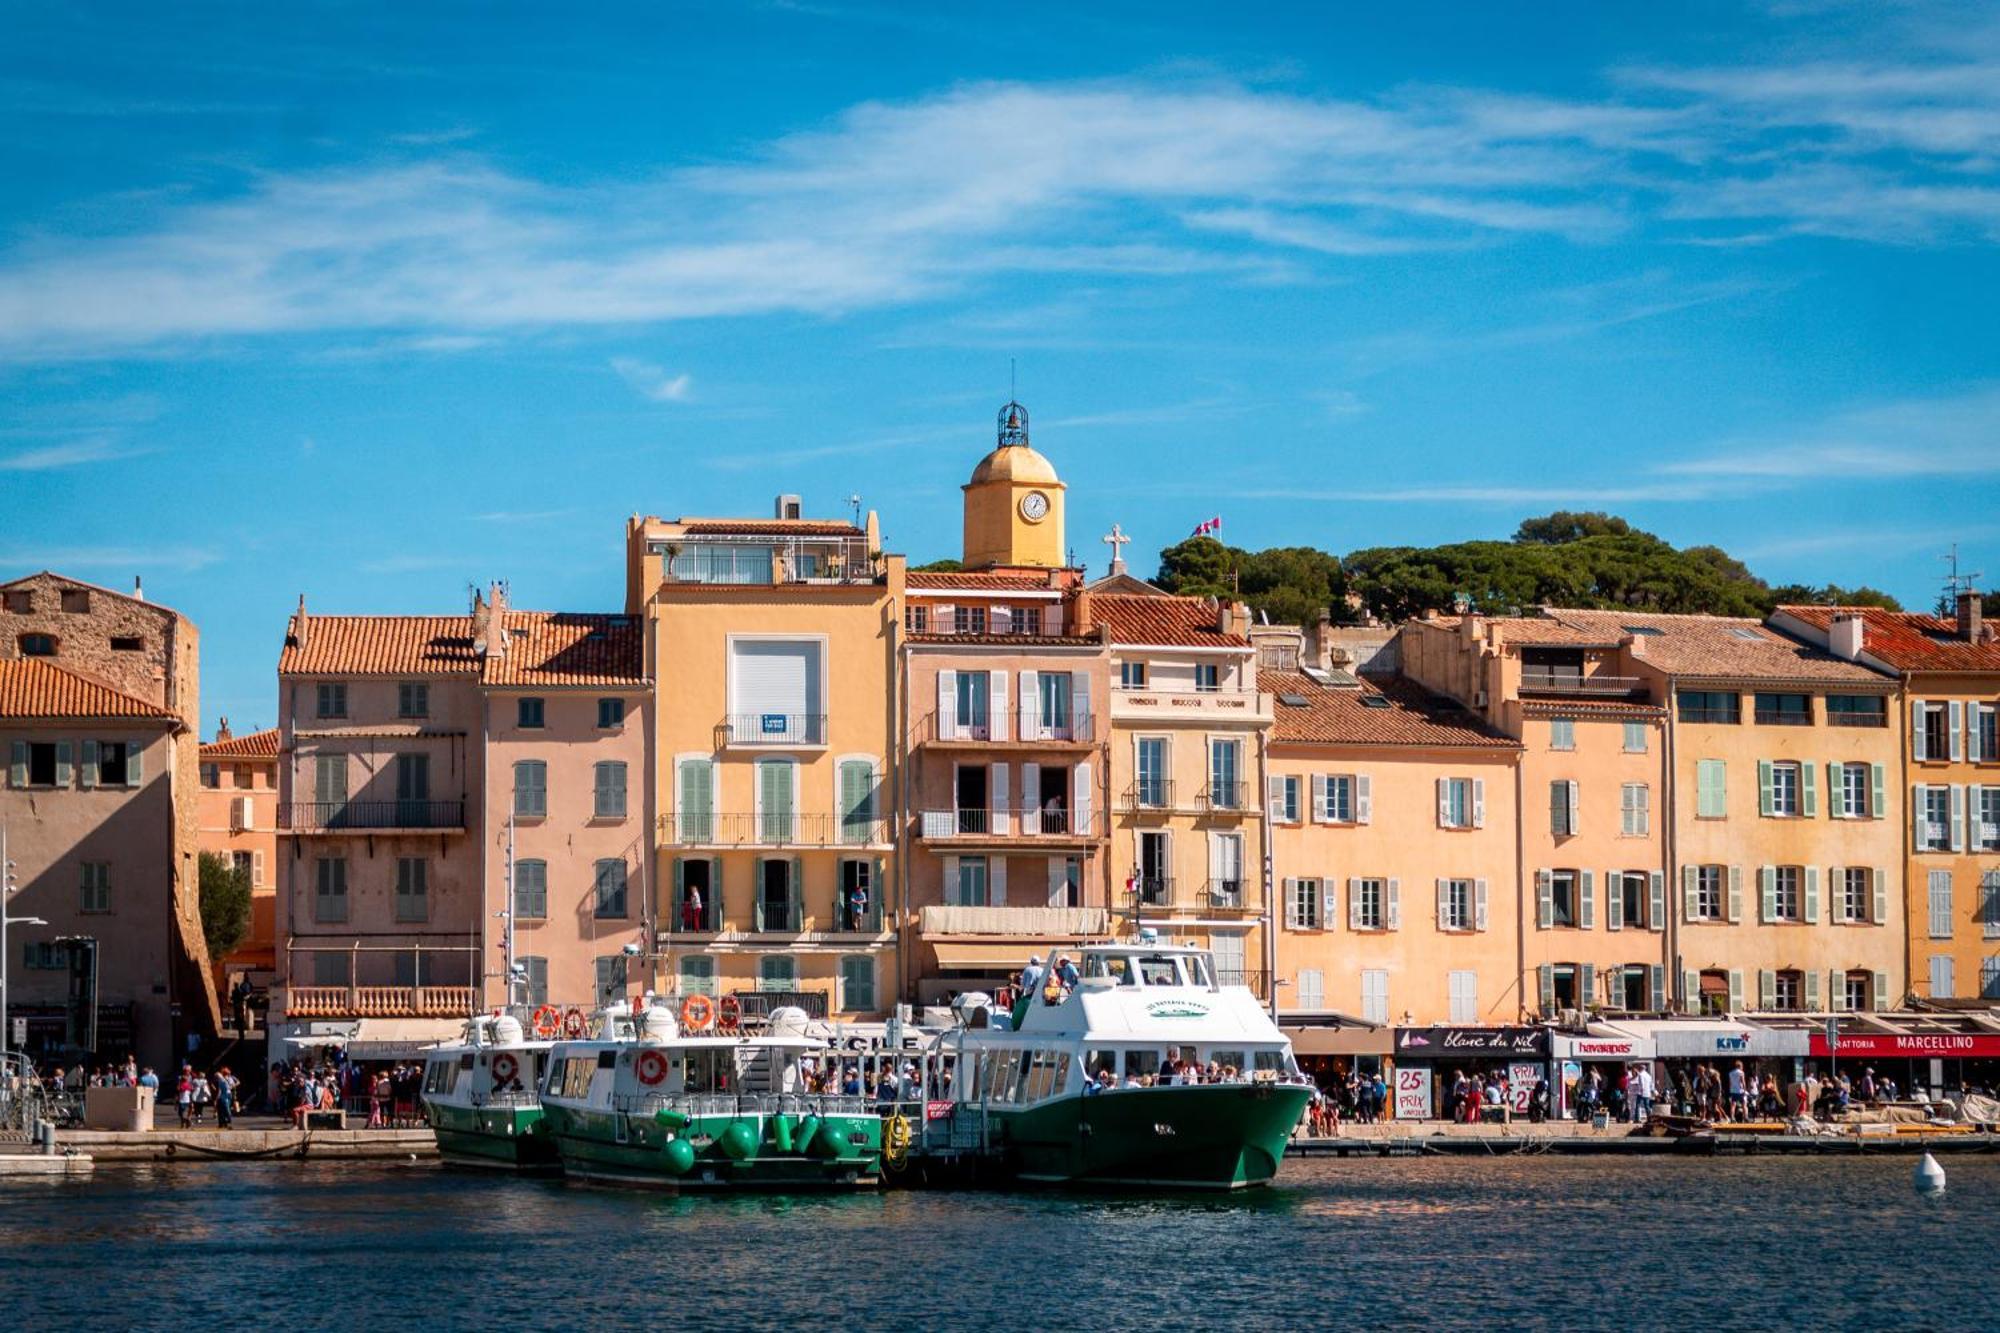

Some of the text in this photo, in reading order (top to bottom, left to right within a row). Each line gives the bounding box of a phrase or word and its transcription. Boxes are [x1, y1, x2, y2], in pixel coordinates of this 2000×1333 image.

[1489, 1031, 1508, 1047] du
[1512, 1032, 1537, 1048] Nil
[1833, 1036, 1974, 1049] RATTORIA MARCELLINO
[1579, 1042, 1632, 1054] havaianas
[1399, 1095, 1425, 1108] PRIX
